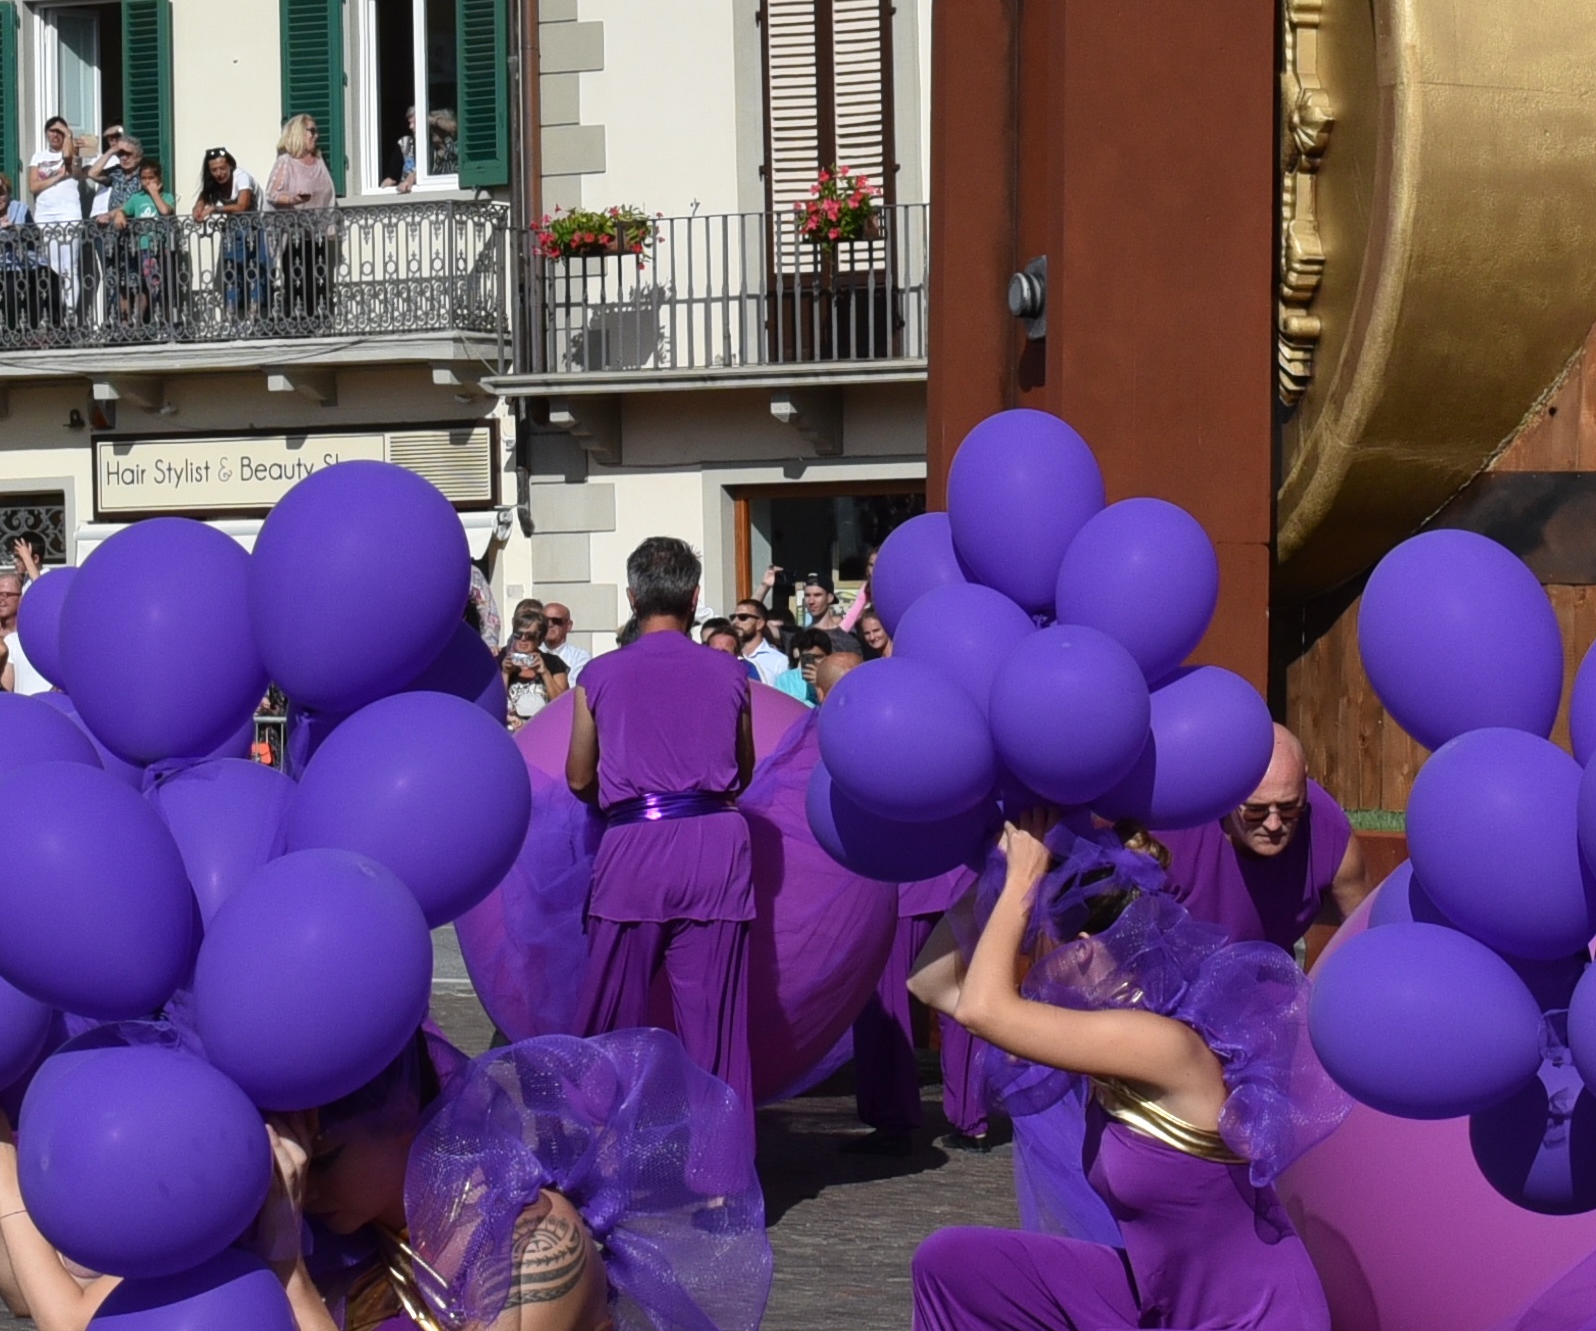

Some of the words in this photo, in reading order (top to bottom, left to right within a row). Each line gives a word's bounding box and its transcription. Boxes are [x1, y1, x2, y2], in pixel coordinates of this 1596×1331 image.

[106, 460, 146, 486] Hair
[154, 458, 210, 489] Stylist
[217, 456, 233, 483] &
[239, 455, 315, 482] Beauty
